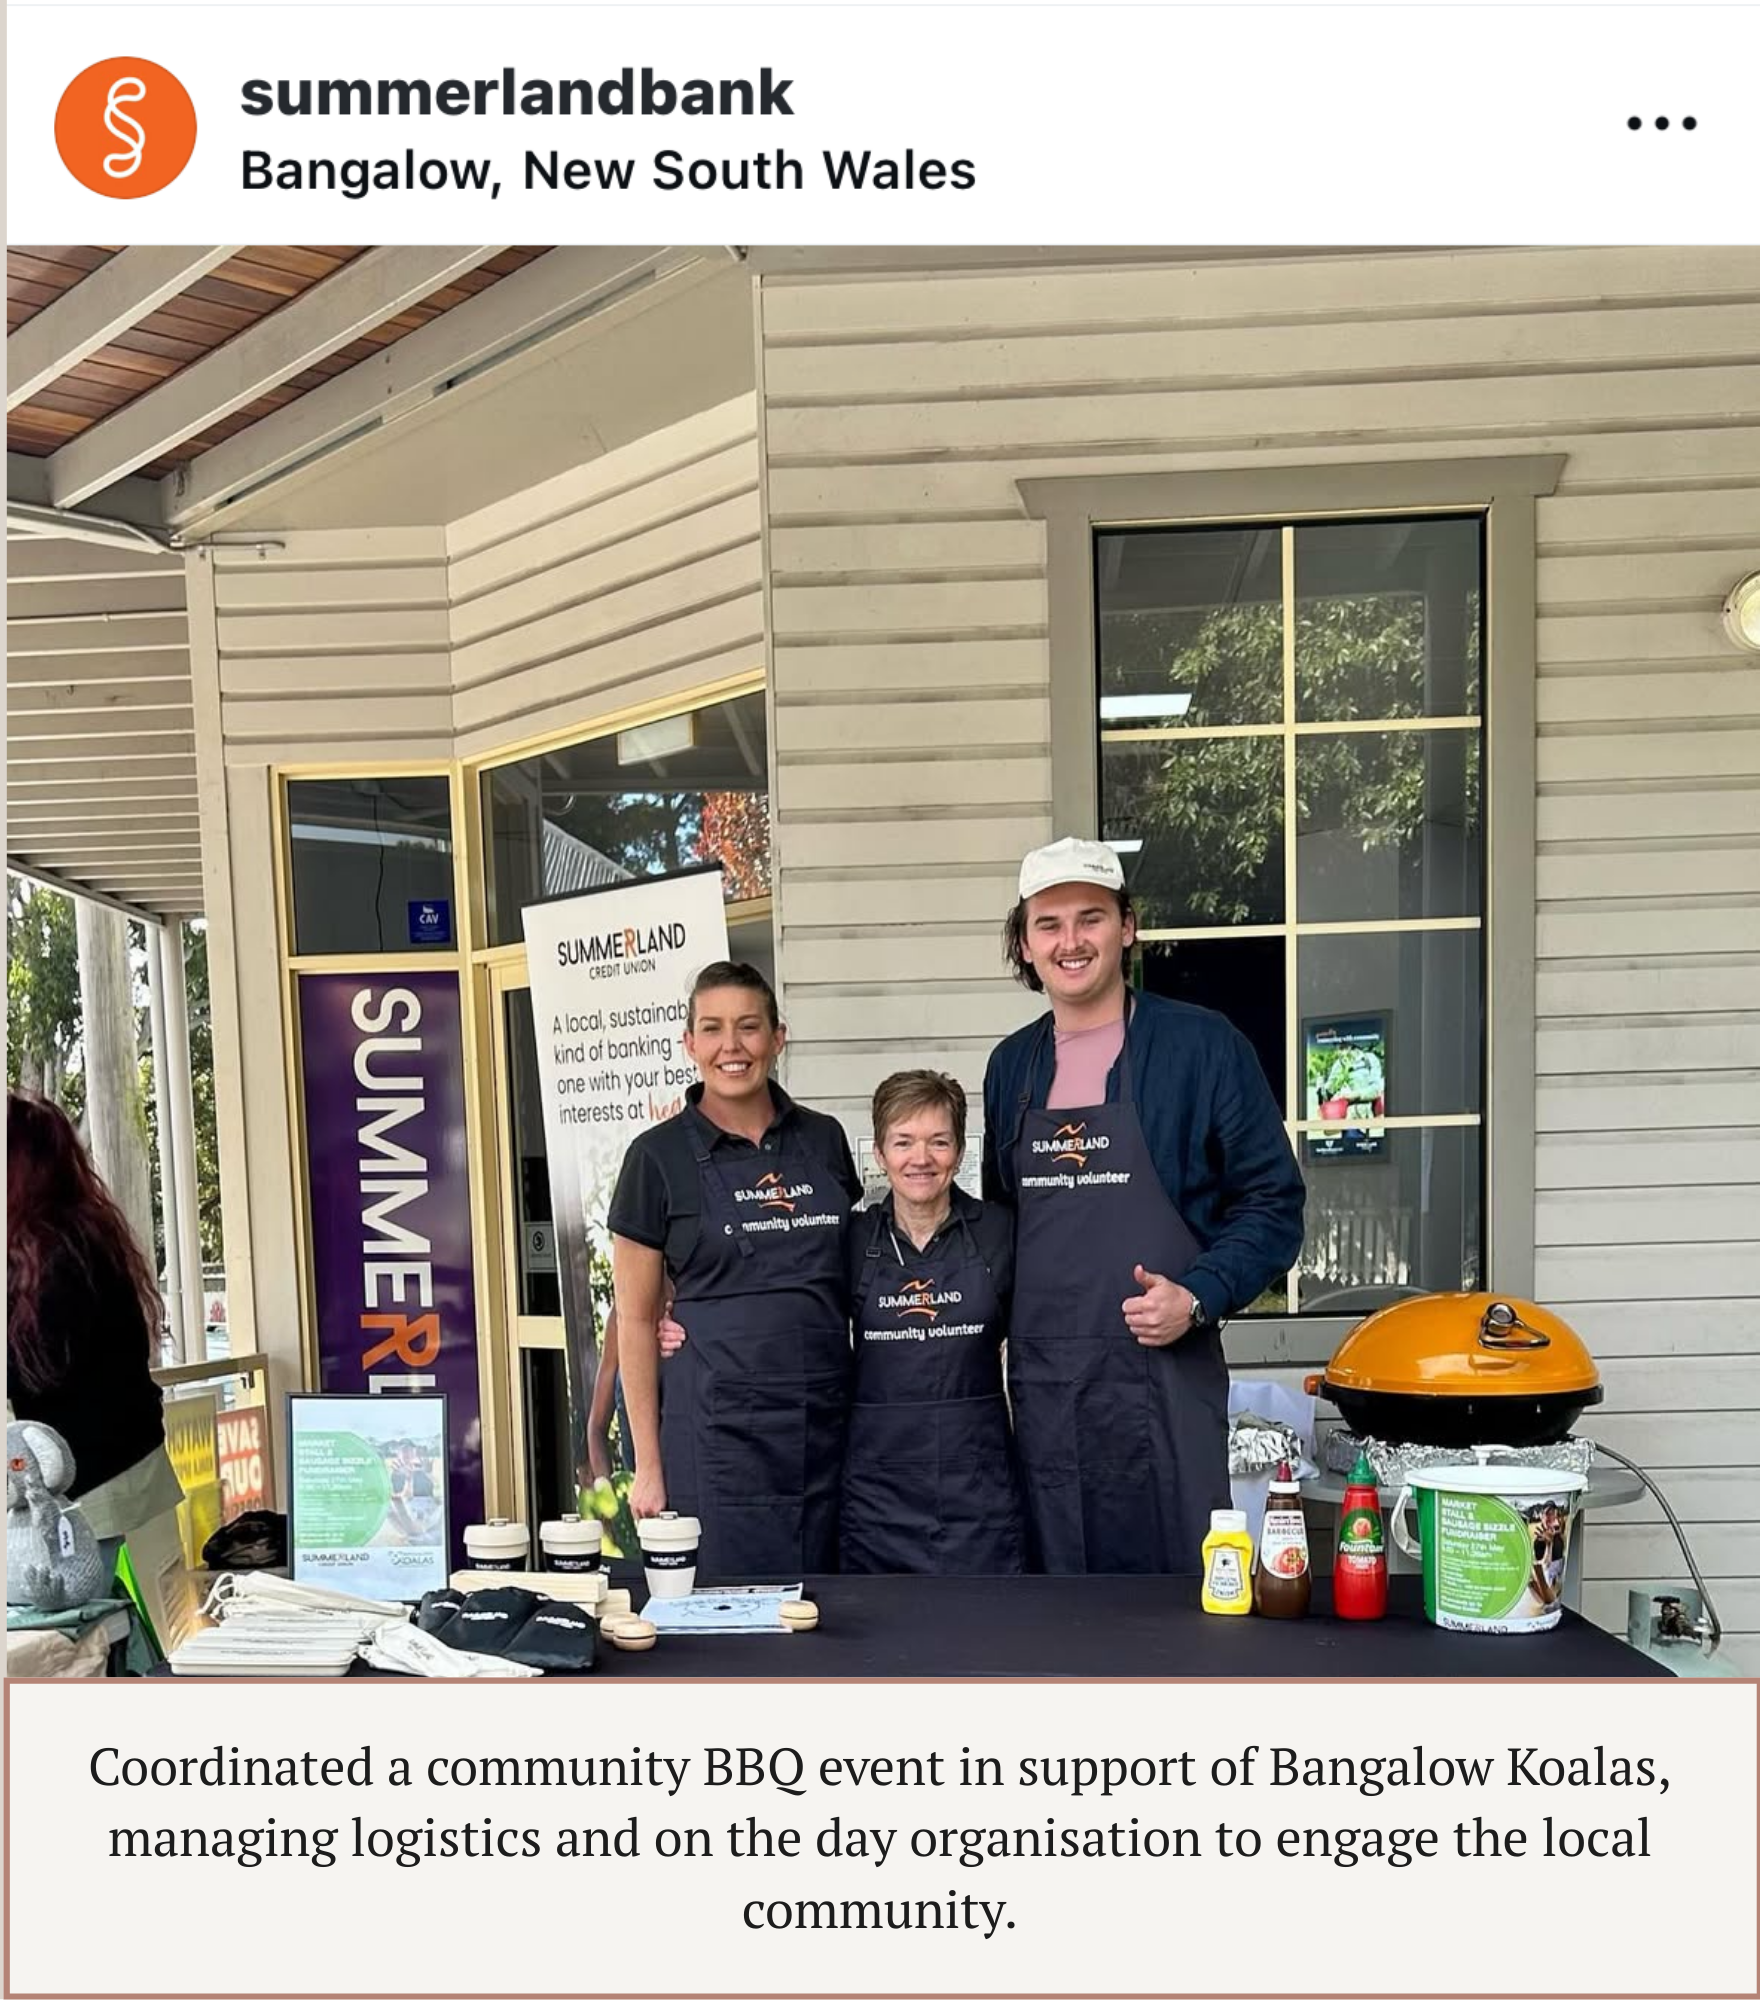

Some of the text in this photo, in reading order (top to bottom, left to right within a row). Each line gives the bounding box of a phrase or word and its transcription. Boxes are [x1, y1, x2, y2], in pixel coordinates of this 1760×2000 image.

[419, 913, 439, 924] CAV
[557, 922, 687, 967] SUMMERLAND
[589, 959, 657, 980] CREDIT UNION
[552, 999, 688, 1035] A local, sustainab
[554, 1042, 585, 1066] kind
[589, 1038, 604, 1062] of
[607, 1034, 672, 1062] banking
[557, 1065, 698, 1096] one with your best
[559, 1091, 682, 1125] interests at hea
[1032, 1135, 1110, 1154] SUMMERLAND
[1076, 1170, 1131, 1185] volunteer
[350, 987, 441, 1395] SUMMERL
[734, 1183, 814, 1202] SUMMERLAND
[791, 1213, 840, 1228] volunteer
[878, 1290, 962, 1308] SUMMERLAND
[864, 1323, 985, 1341] community volunteer
